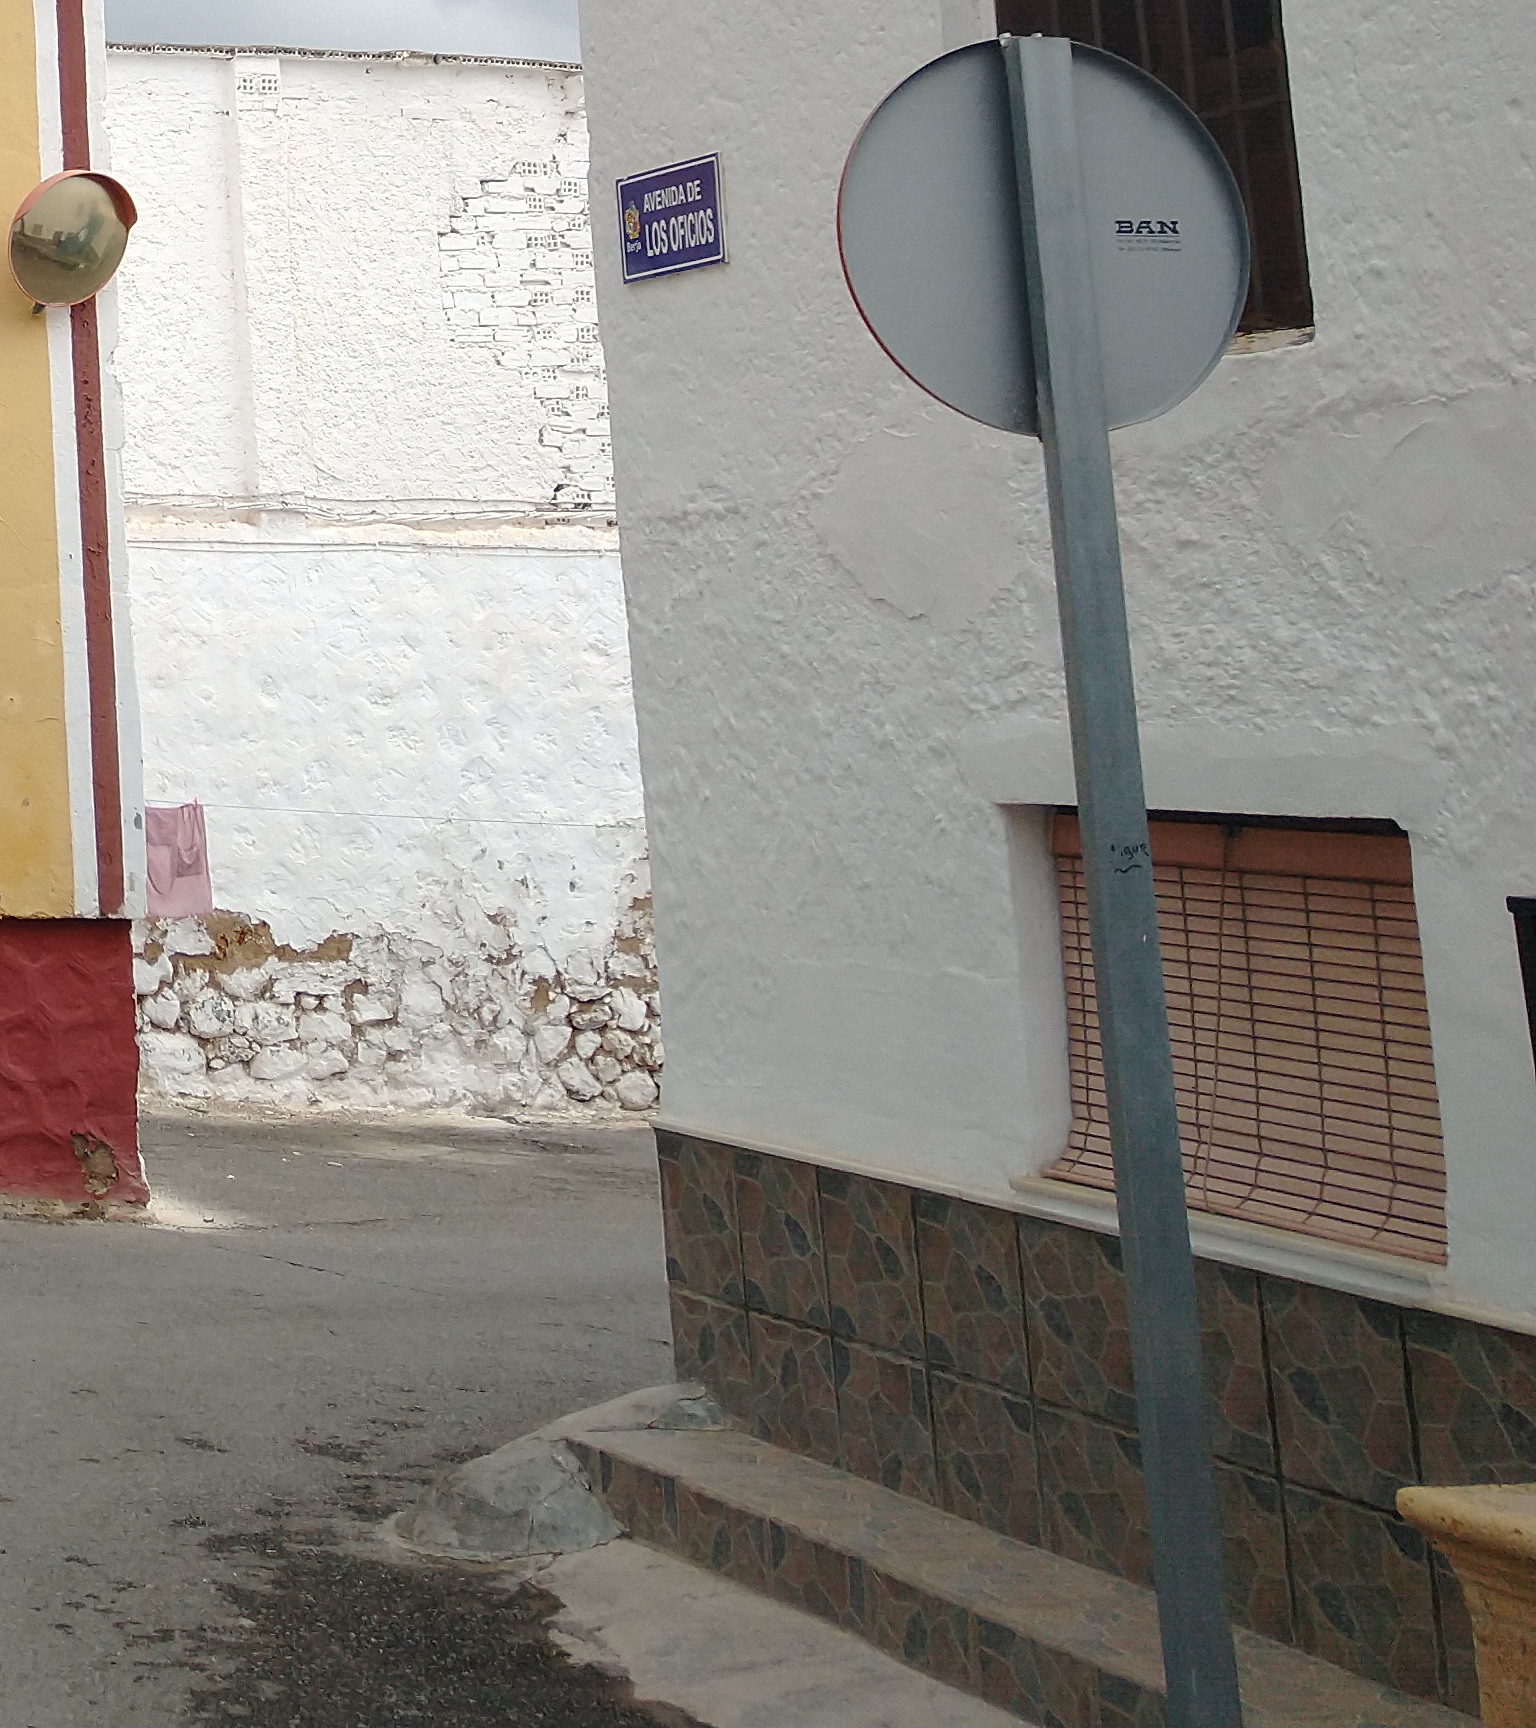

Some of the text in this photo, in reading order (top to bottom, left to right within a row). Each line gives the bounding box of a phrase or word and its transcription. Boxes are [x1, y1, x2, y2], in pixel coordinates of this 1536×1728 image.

[643, 179, 702, 213] AVENIDA DE
[645, 208, 715, 257] LOS OFICIOS
[1115, 220, 1179, 234] BAN
